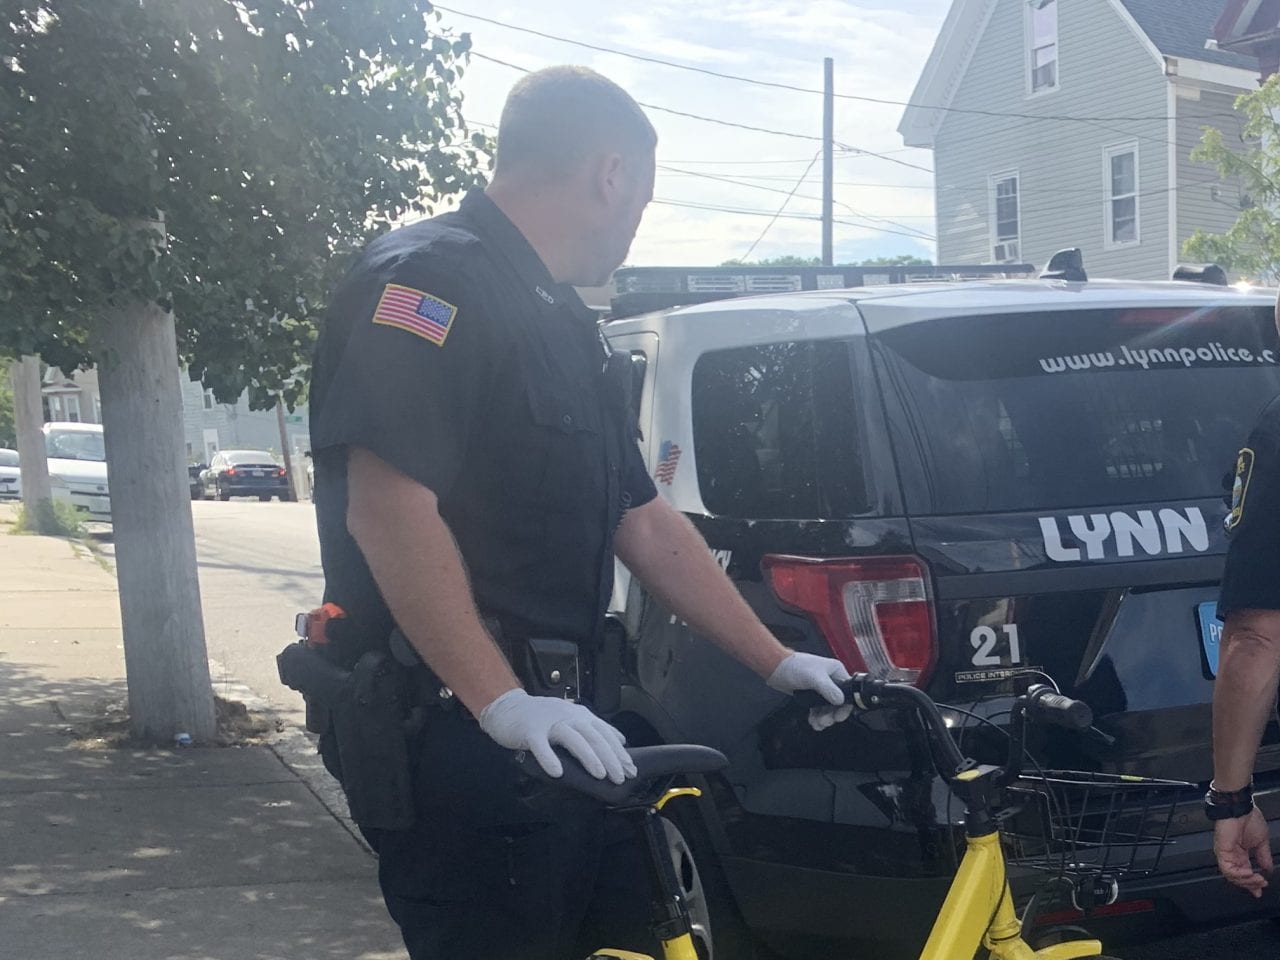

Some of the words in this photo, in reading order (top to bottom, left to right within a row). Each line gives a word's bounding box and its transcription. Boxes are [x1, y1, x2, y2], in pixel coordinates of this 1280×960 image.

[1039, 342, 1276, 373] www.lynnpolice.c
[1039, 507, 1209, 561] LYNN
[970, 624, 1021, 667] 21
